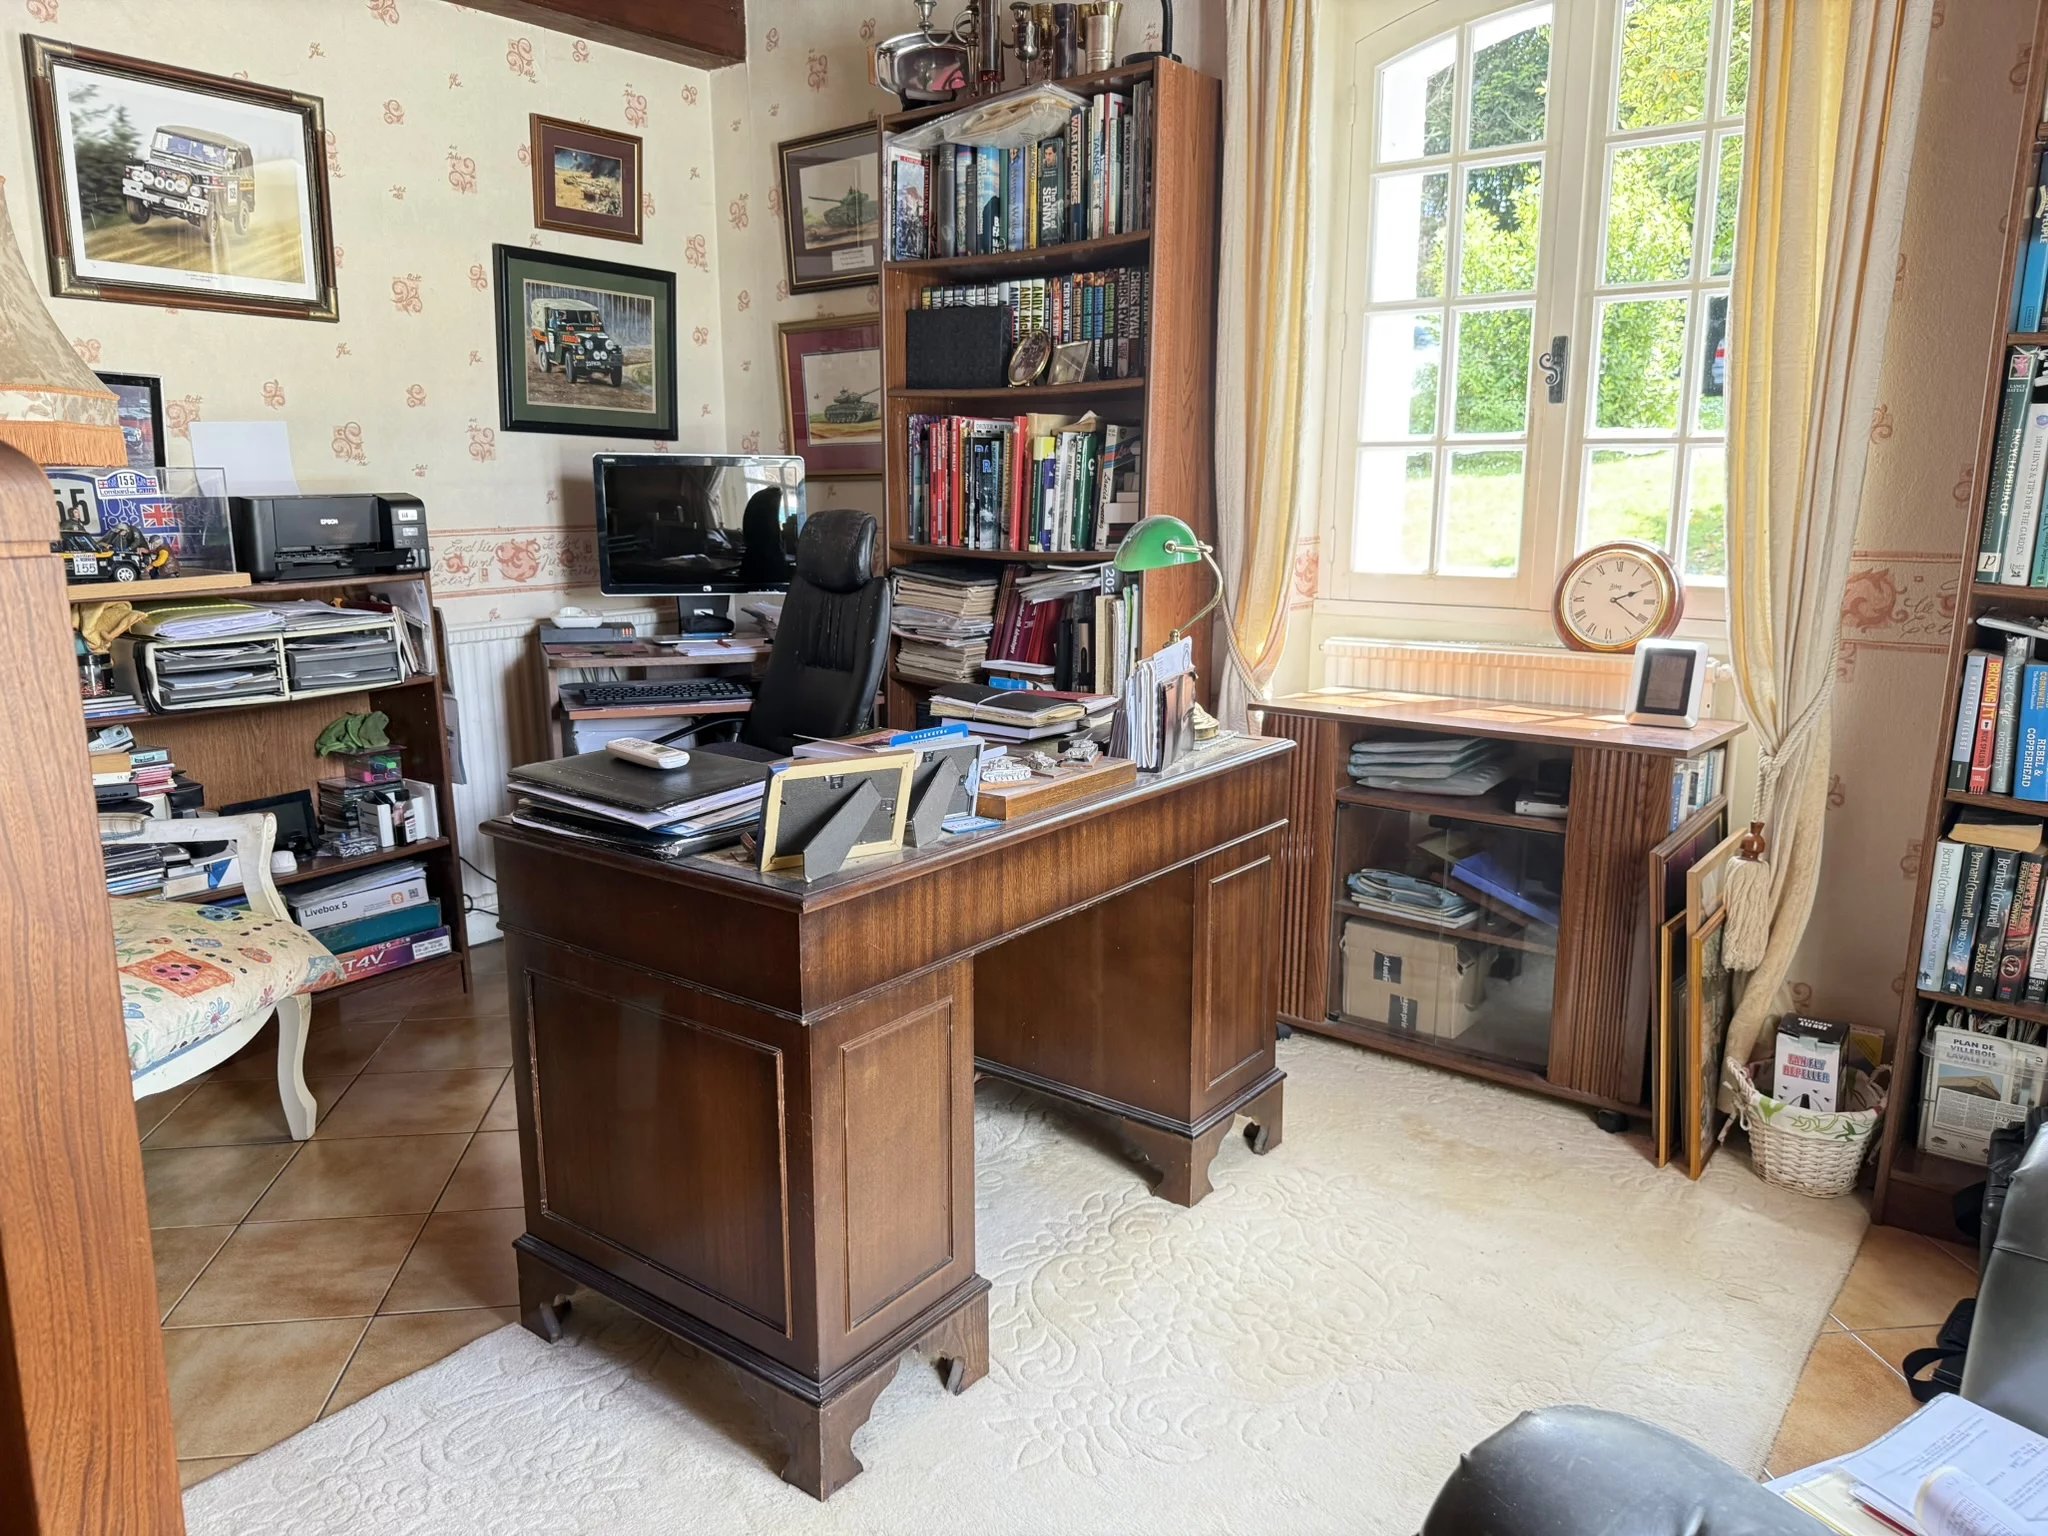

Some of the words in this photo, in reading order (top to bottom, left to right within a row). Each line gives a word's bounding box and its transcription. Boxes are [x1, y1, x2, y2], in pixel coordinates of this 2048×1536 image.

[1071, 114, 1079, 142] WAR
[1093, 137, 1101, 177] TANKS
[1070, 145, 1079, 205] MACHINES
[1042, 187, 1051, 230] SENNA
[1050, 220, 1058, 229] of
[1020, 287, 1031, 311] ANDY
[1032, 286, 1043, 311] ANDY
[1073, 288, 1081, 315] CHRIS
[1084, 287, 1092, 314] CHRIS
[1095, 287, 1103, 314] CHRIS
[1105, 283, 1115, 310] CHRIS
[1118, 272, 1129, 305] CHRIS
[1130, 271, 1141, 304] CHRIS
[1073, 316, 1081, 340] RYAN
[1083, 315, 1091, 339] RYAN
[1094, 315, 1103, 338] RYAN
[1105, 311, 1114, 334] RYAN
[1118, 307, 1128, 338] RYAN
[1130, 306, 1140, 338] RYAN
[2000, 398, 2013, 438] GARDEN
[2034, 435, 2043, 449] 1001
[1993, 440, 2006, 478] PLANTS
[2001, 428, 2022, 502] ENCYCLOPEDIA
[2029, 450, 2040, 471] HINTS
[118, 475, 135, 486] 155
[1102, 472, 1111, 500] Lancia
[1990, 480, 2001, 499] AND
[2026, 480, 2035, 495] TIPS
[2000, 502, 2010, 517] OF
[2023, 495, 2032, 511] FOR
[1982, 500, 1997, 546] FLOWERS
[2021, 511, 2030, 526] THE
[2016, 526, 2027, 557] GARDEN
[76, 564, 97, 574] 155
[1105, 568, 1115, 594] 202
[1985, 662, 2000, 703] BRICKING
[2007, 664, 2020, 689] Stone
[2036, 671, 2047, 710] CORNWELL
[1982, 707, 1996, 719] IT
[1959, 719, 1972, 751] VILLAGE
[1995, 732, 2005, 769] DOUGHTY
[2022, 728, 2036, 787] COPPERHEAD
[2034, 739, 2046, 768] REBEL
[1940, 847, 1954, 878] Bernard
[1968, 851, 1983, 882] Bernard
[1994, 857, 2010, 892] Bernard
[2016, 861, 2029, 893] BERNARD
[304, 903, 340, 918] Livebox
[342, 901, 348, 909] 5
[1933, 879, 1950, 913] Cornwell
[1961, 883, 1978, 918] Cornwell
[1986, 892, 2003, 928] Cornwell
[2009, 895, 2022, 930] CORNWELL
[1957, 918, 1969, 941] SWORD
[1974, 943, 1987, 973] BEARER
[1983, 949, 1995, 978] FLAME
[2033, 935, 2048, 973] Cornwell
[1946, 1052, 1998, 1066] LAVALETTE
[1950, 1045, 1996, 1058] VILLEBOIS
[1953, 1039, 1978, 1048] PLAN
[1982, 1043, 1994, 1051] DE
[1782, 1064, 1830, 1084] REPELLER
